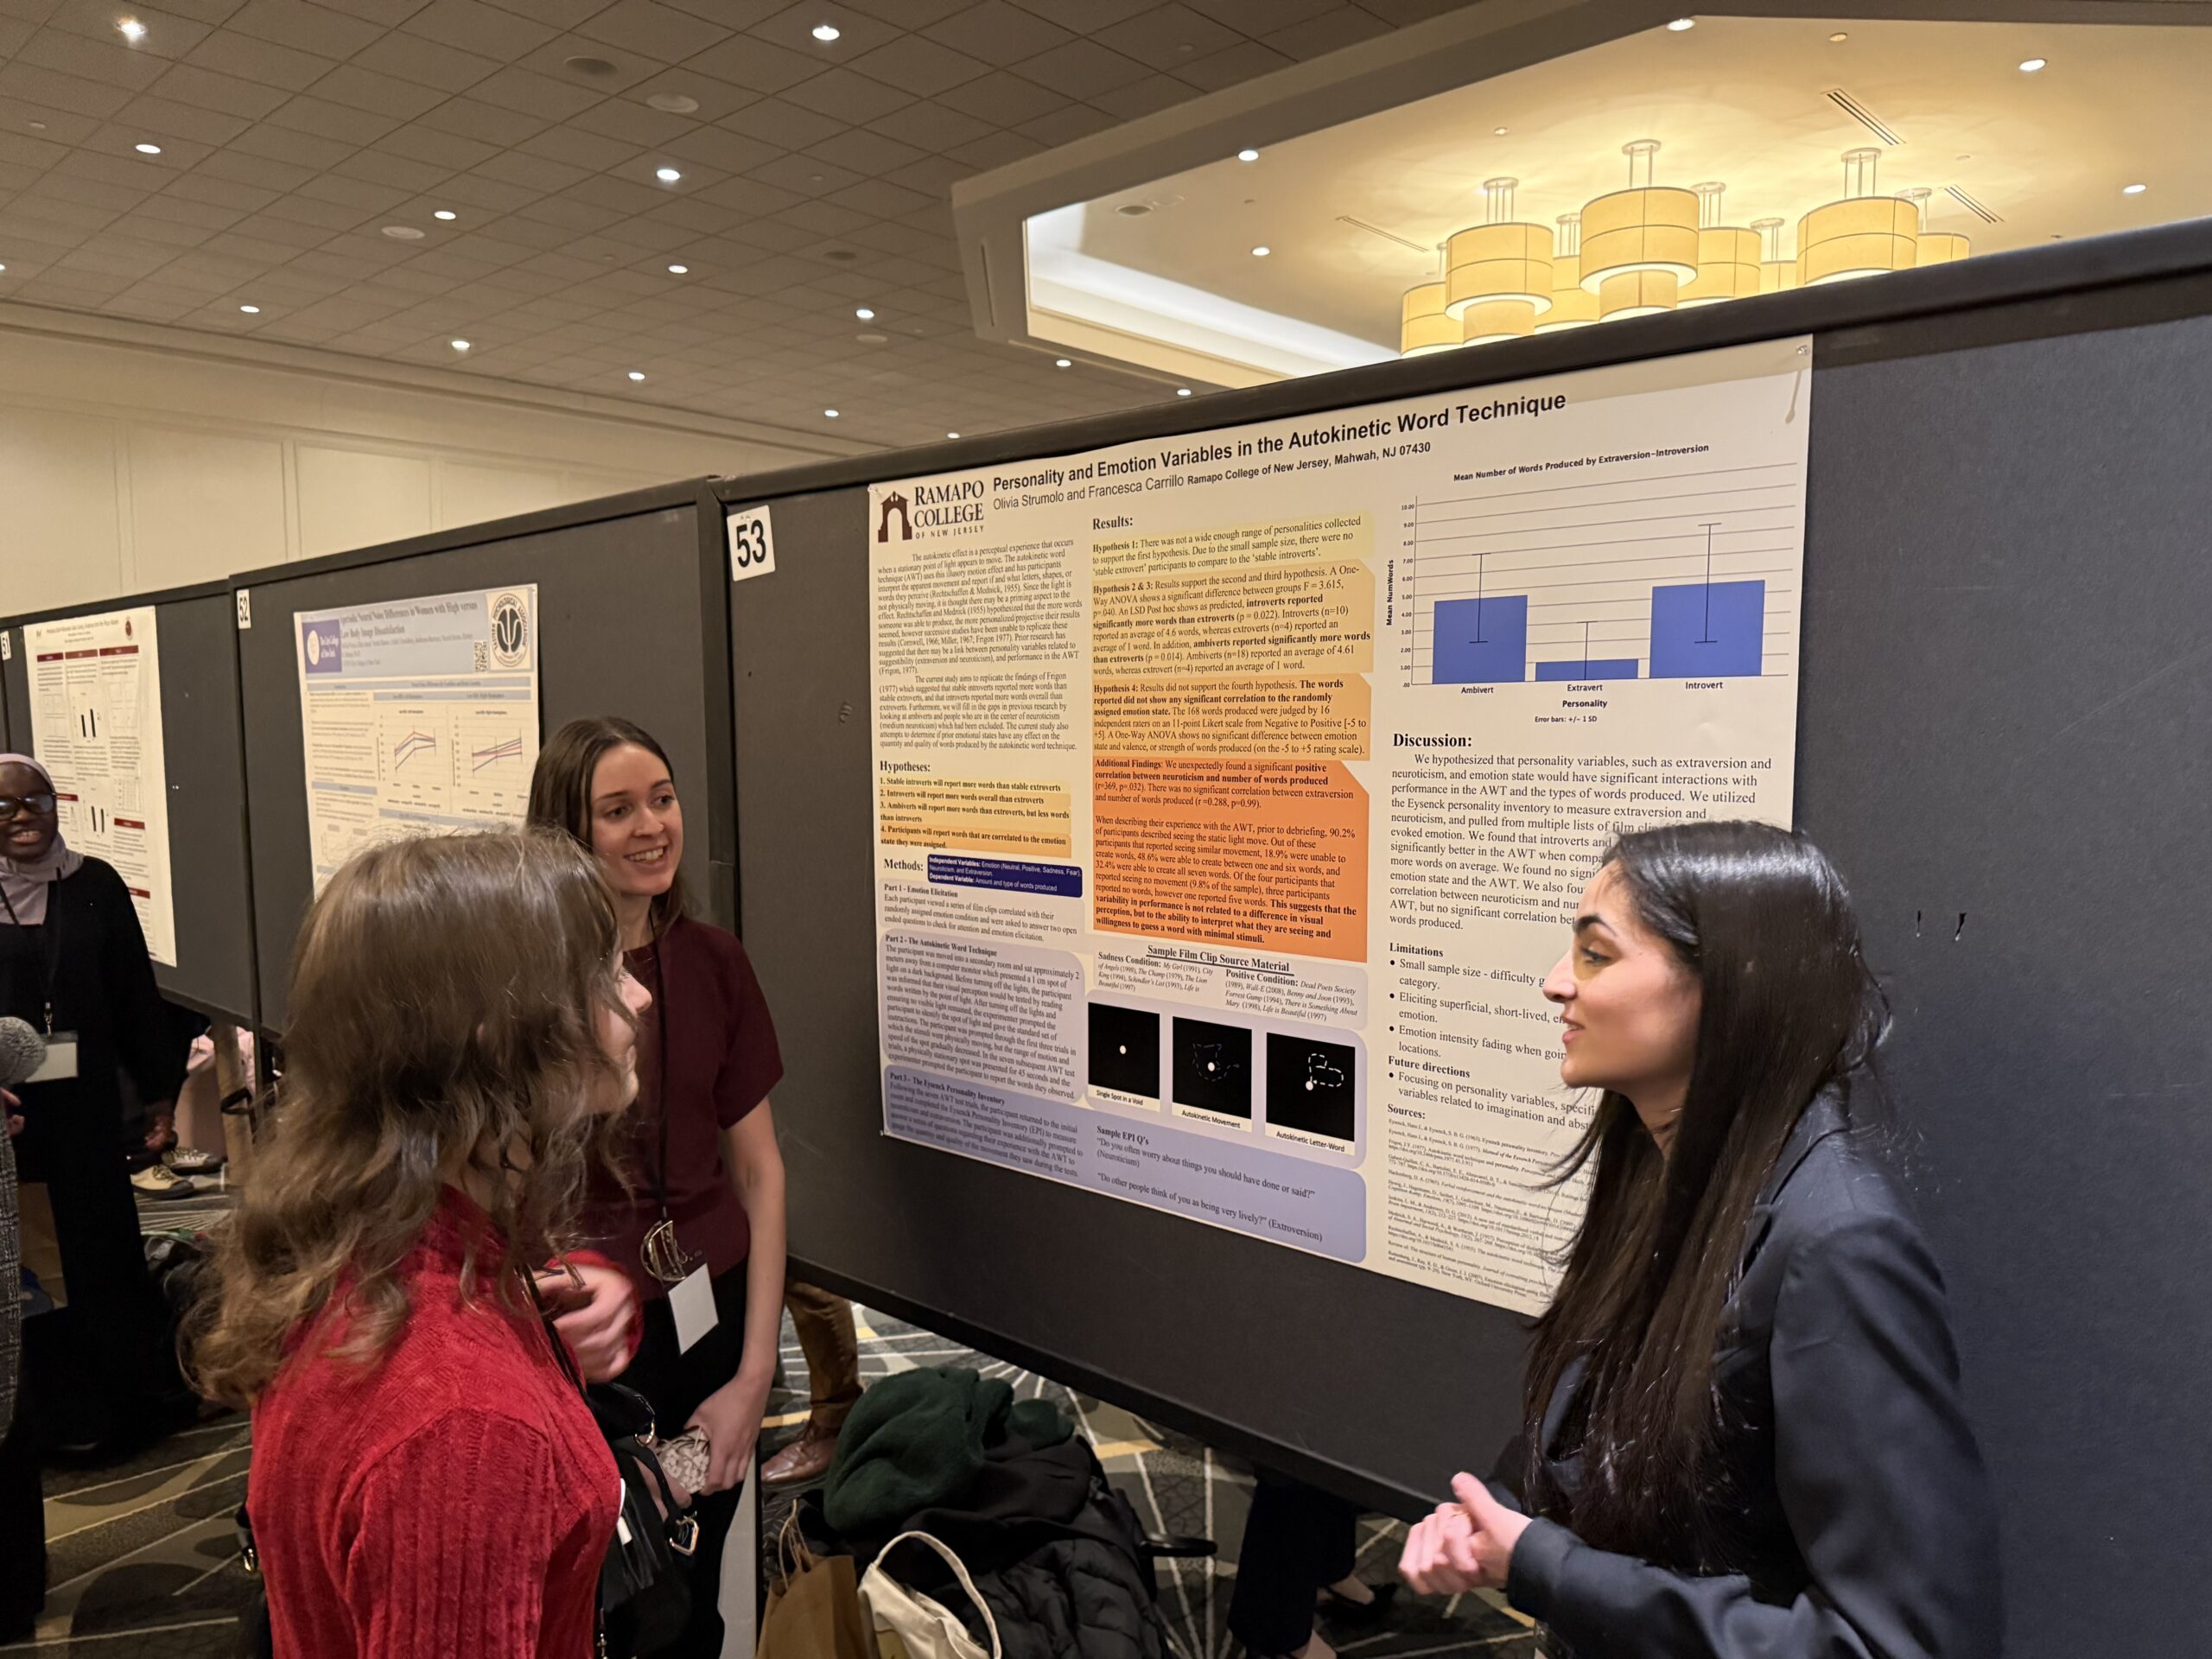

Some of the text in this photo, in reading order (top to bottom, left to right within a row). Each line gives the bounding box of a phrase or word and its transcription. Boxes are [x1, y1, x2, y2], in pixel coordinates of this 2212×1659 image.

[993, 395, 1566, 491] Personality and Emotion Variables in the Autokinetic Word Technique
[993, 442, 1430, 510] Olivia Strumolo and Francesca Carrillo Ramapo College of New Jersey, Mahwah, NJ 07430
[1475, 469, 1506, 478] Number
[1508, 466, 1516, 474] of
[1518, 463, 1542, 474] Words
[1545, 457, 1583, 470] Produced
[1586, 457, 1596, 466] by
[914, 480, 984, 506] RAMAPO
[914, 503, 984, 528] COLLEGE
[1093, 515, 1133, 530] Results:
[931, 529, 949, 537] NEW
[953, 525, 984, 537] JERSEY
[1092, 541, 1129, 554] Hypothesis
[1132, 540, 1138, 549] 1:
[1140, 538, 1159, 548] There
[1175, 536, 1186, 544] not
[1194, 532, 1211, 542] wide
[1212, 529, 1239, 541] enough
[1241, 529, 1262, 538] range
[1263, 524, 1273, 535] of
[1274, 520, 1322, 537] personalities
[1324, 515, 1360, 529] collected
[736, 519, 766, 569] 53
[239, 596, 249, 622] 52
[447, 602, 461, 615] High
[3, 637, 10, 656] 51
[1562, 699, 1607, 709] Personality
[1393, 733, 1471, 747] Discussion:
[880, 760, 930, 773] Hypotheses:
[1095, 759, 1129, 767] Additional
[1131, 759, 1162, 770] Findings:
[1165, 760, 1176, 768] We
[1178, 760, 1223, 772] unexpectedly
[1225, 760, 1246, 770] found
[1254, 761, 1293, 772] significant
[1294, 762, 1326, 773] positive
[1414, 753, 1429, 763] We
[1432, 753, 1493, 766] hypothesized
[1497, 754, 1515, 765] that
[1517, 755, 1573, 768] personality
[1577, 755, 1628, 768] variables,
[1631, 756, 1656, 766] such
[1675, 757, 1747, 768] extraversion
[1751, 758, 1771, 768] and
[1392, 768, 1757, 785] neuroticism, and emotion state would have significant interactions with
[884, 858, 923, 871] Methods:
[1147, 944, 1290, 972] Sample Film Clip Source Material
[1389, 942, 1443, 957] Limitations
[1098, 951, 1160, 967] Sadness Condition:
[1226, 969, 1298, 986] Positive Condition:
[1399, 958, 1425, 970] Small
[1427, 963, 1459, 976] sample
[1462, 965, 1481, 977] size
[1490, 969, 1535, 986] difficulty
[1389, 1055, 1470, 1077] Future directions
[1096, 1090, 1109, 1098] Single
[1110, 1092, 1122, 1101] Spot
[1398, 1071, 1557, 1110] Focusing on personality variables,
[1181, 1109, 1240, 1128] Autokinetic Movement
[1388, 1103, 1425, 1119] Sources:
[1096, 1125, 1121, 1138] Sample
[1122, 1131, 1135, 1141] EPI
[1276, 1131, 1344, 1152] Autokinetic Letter-Word
